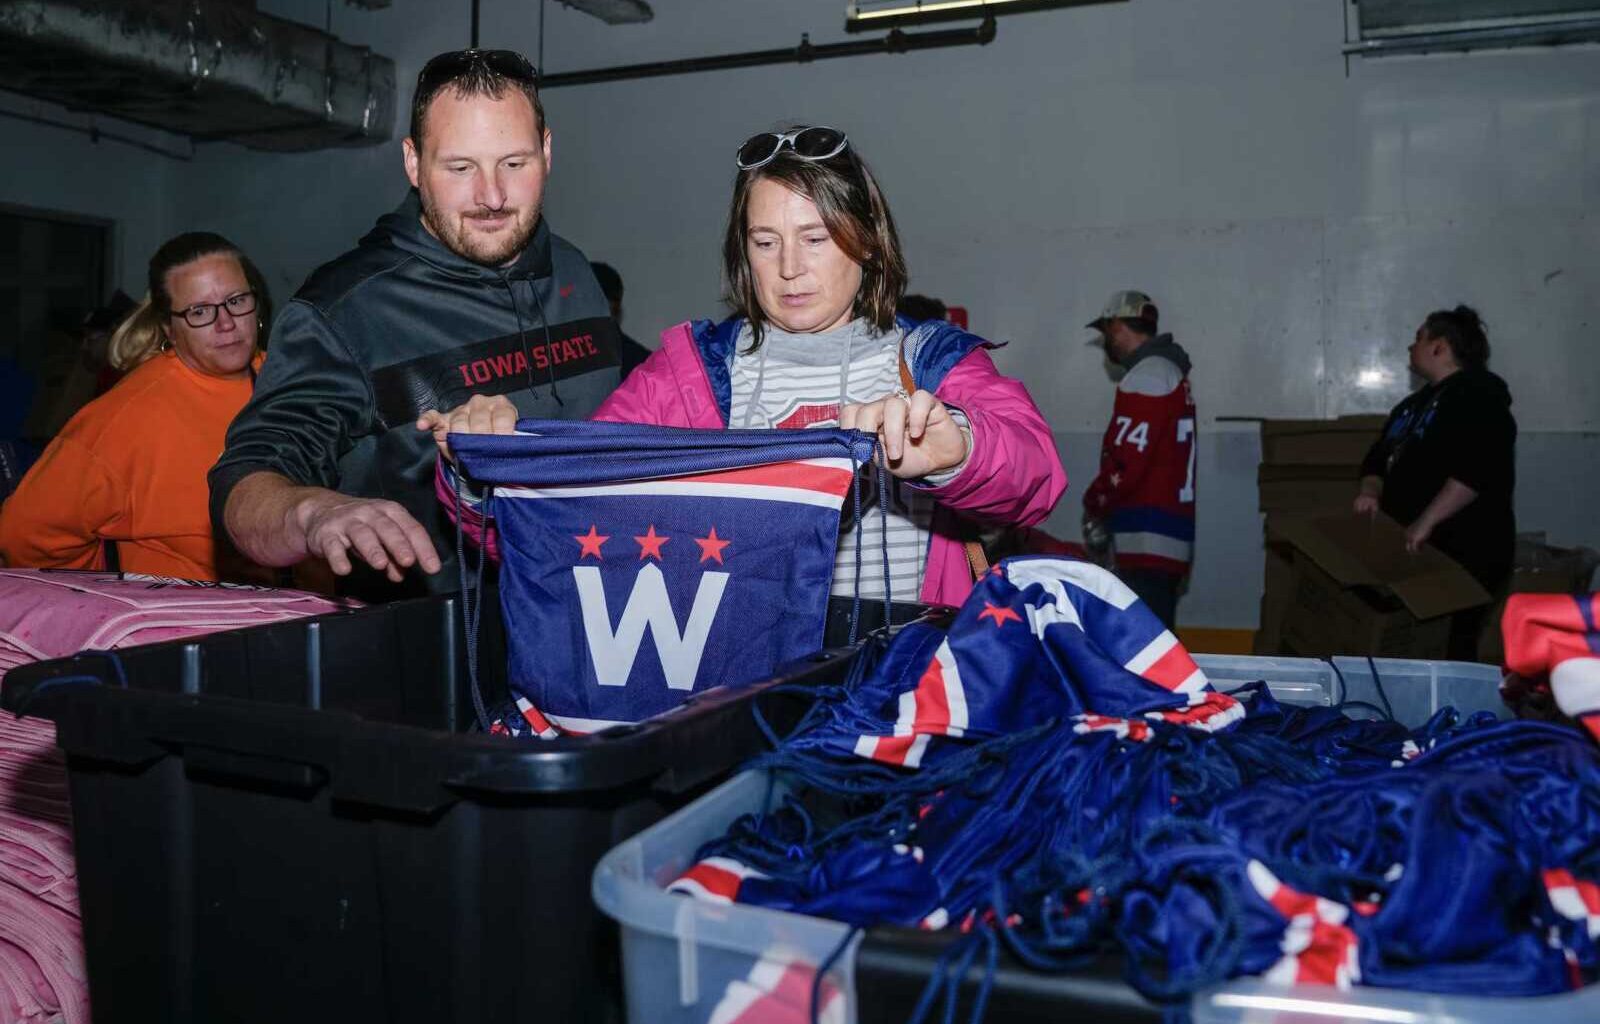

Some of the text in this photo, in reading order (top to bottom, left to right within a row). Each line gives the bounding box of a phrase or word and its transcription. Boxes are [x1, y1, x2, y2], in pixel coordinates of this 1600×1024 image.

[458, 334, 600, 387] IOWA STATE
[1114, 415, 1150, 452] 74
[572, 561, 731, 691] W
